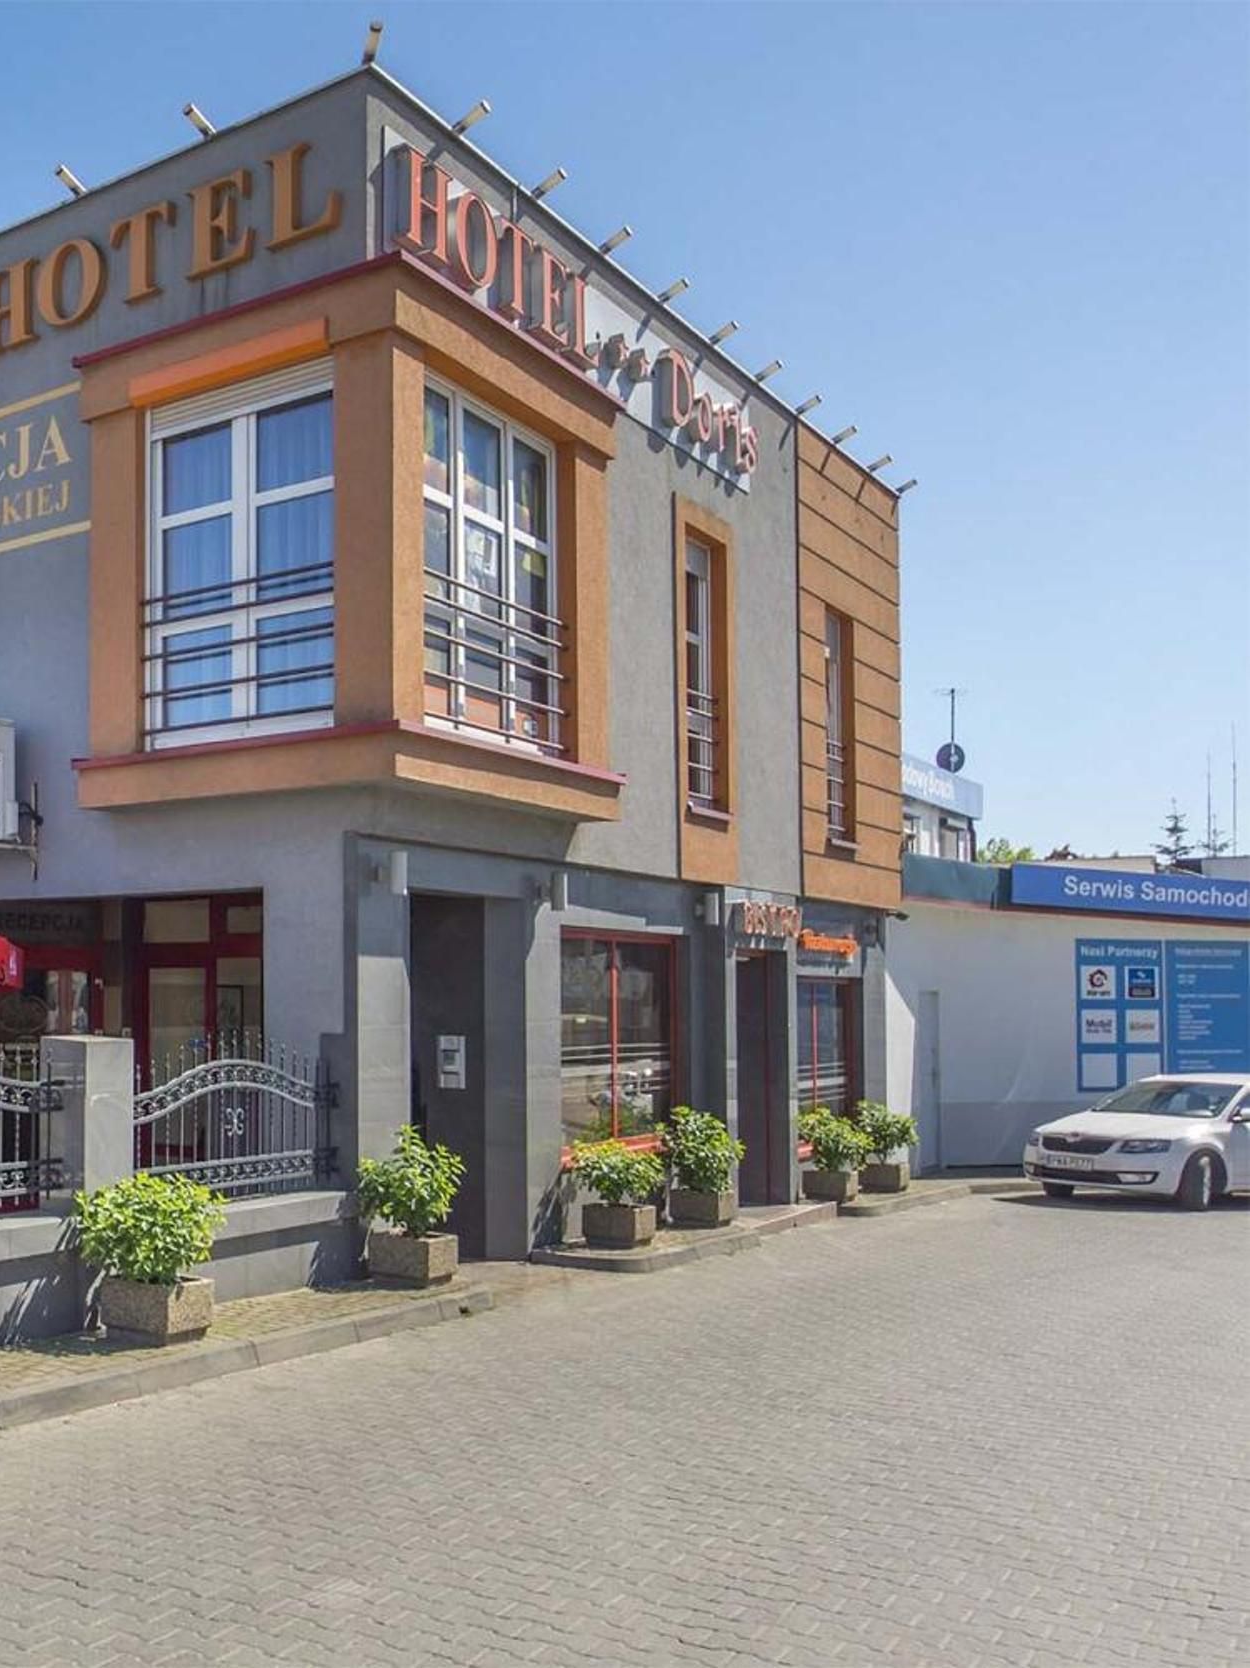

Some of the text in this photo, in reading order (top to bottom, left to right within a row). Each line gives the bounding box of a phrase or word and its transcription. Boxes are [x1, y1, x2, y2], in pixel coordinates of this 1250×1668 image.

[398, 145, 759, 475] HOTEL Doris
[1064, 875, 1135, 900] Serwis
